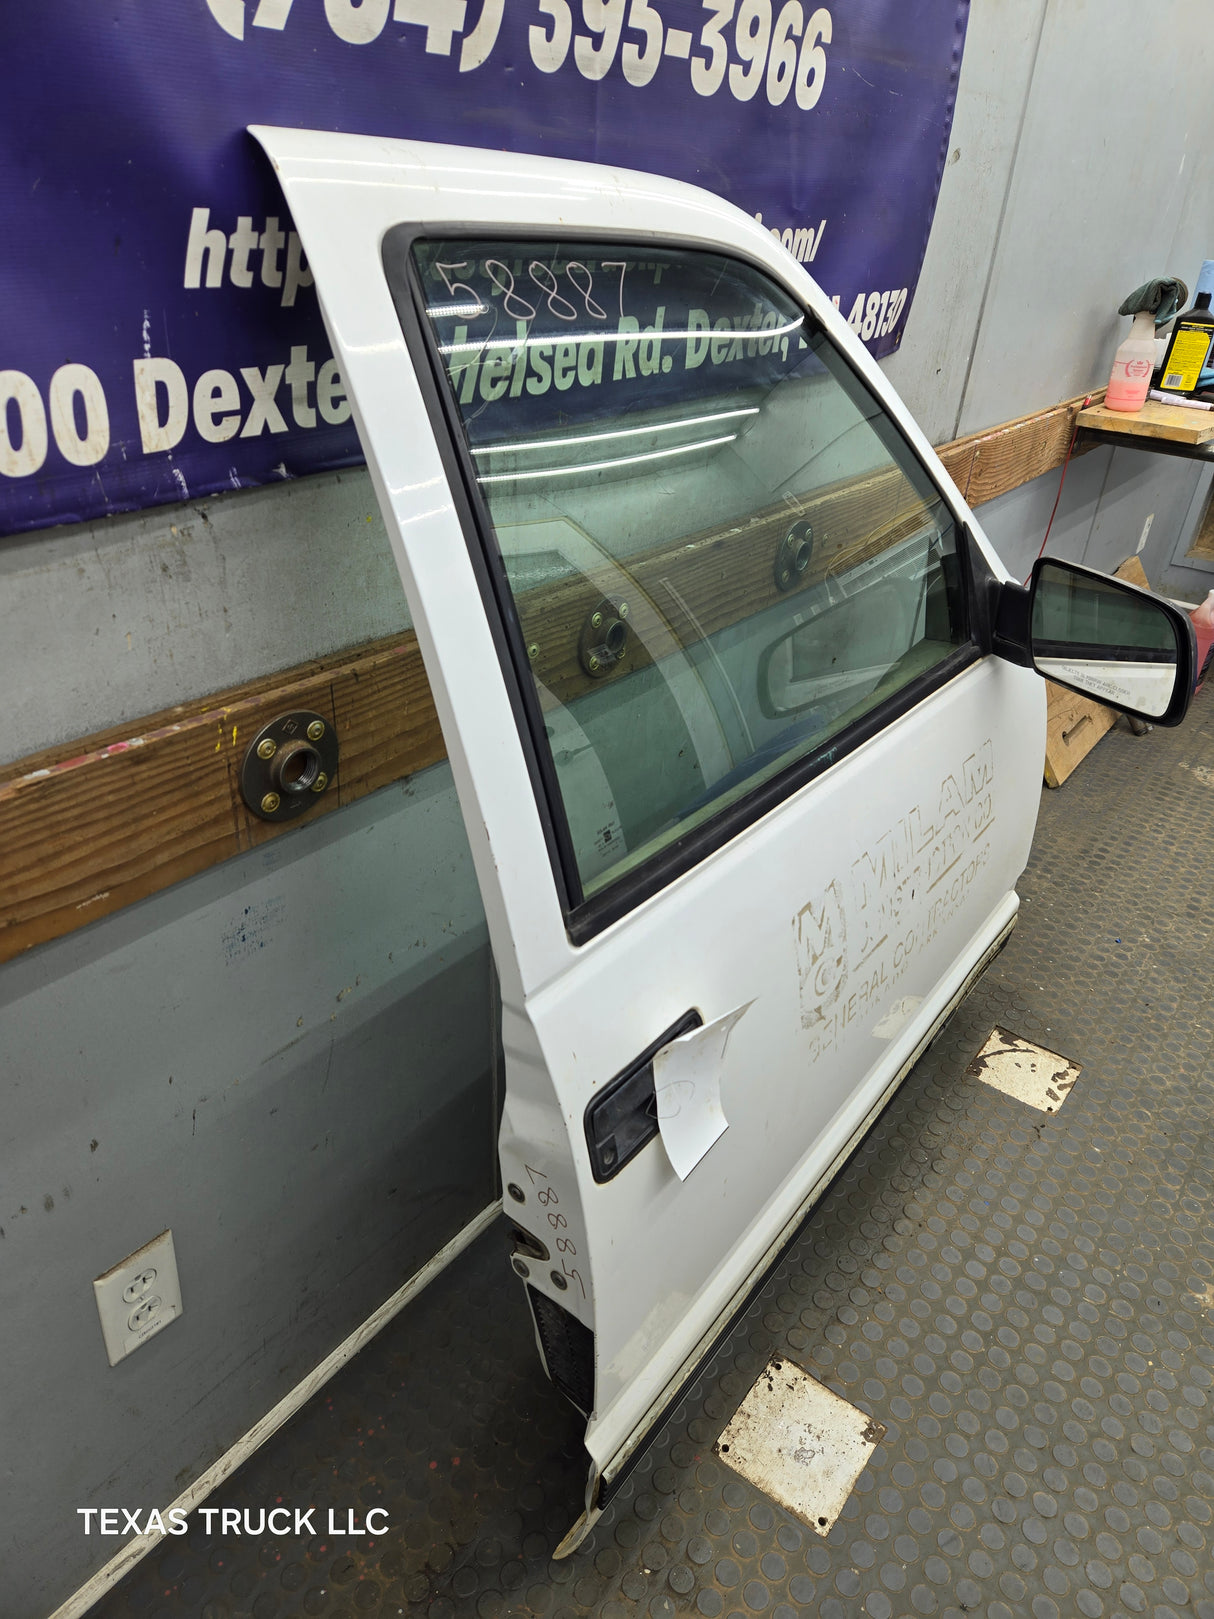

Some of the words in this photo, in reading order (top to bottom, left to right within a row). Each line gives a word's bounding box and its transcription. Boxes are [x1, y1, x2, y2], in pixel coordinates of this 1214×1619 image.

[528, 0, 833, 111] 395-3966
[435, 260, 627, 320] 58887
[613, 306, 673, 381] Rd.
[685, 303, 789, 370] Dexter,
[847, 287, 908, 342] 48130
[524, 1164, 586, 1300] 58887
